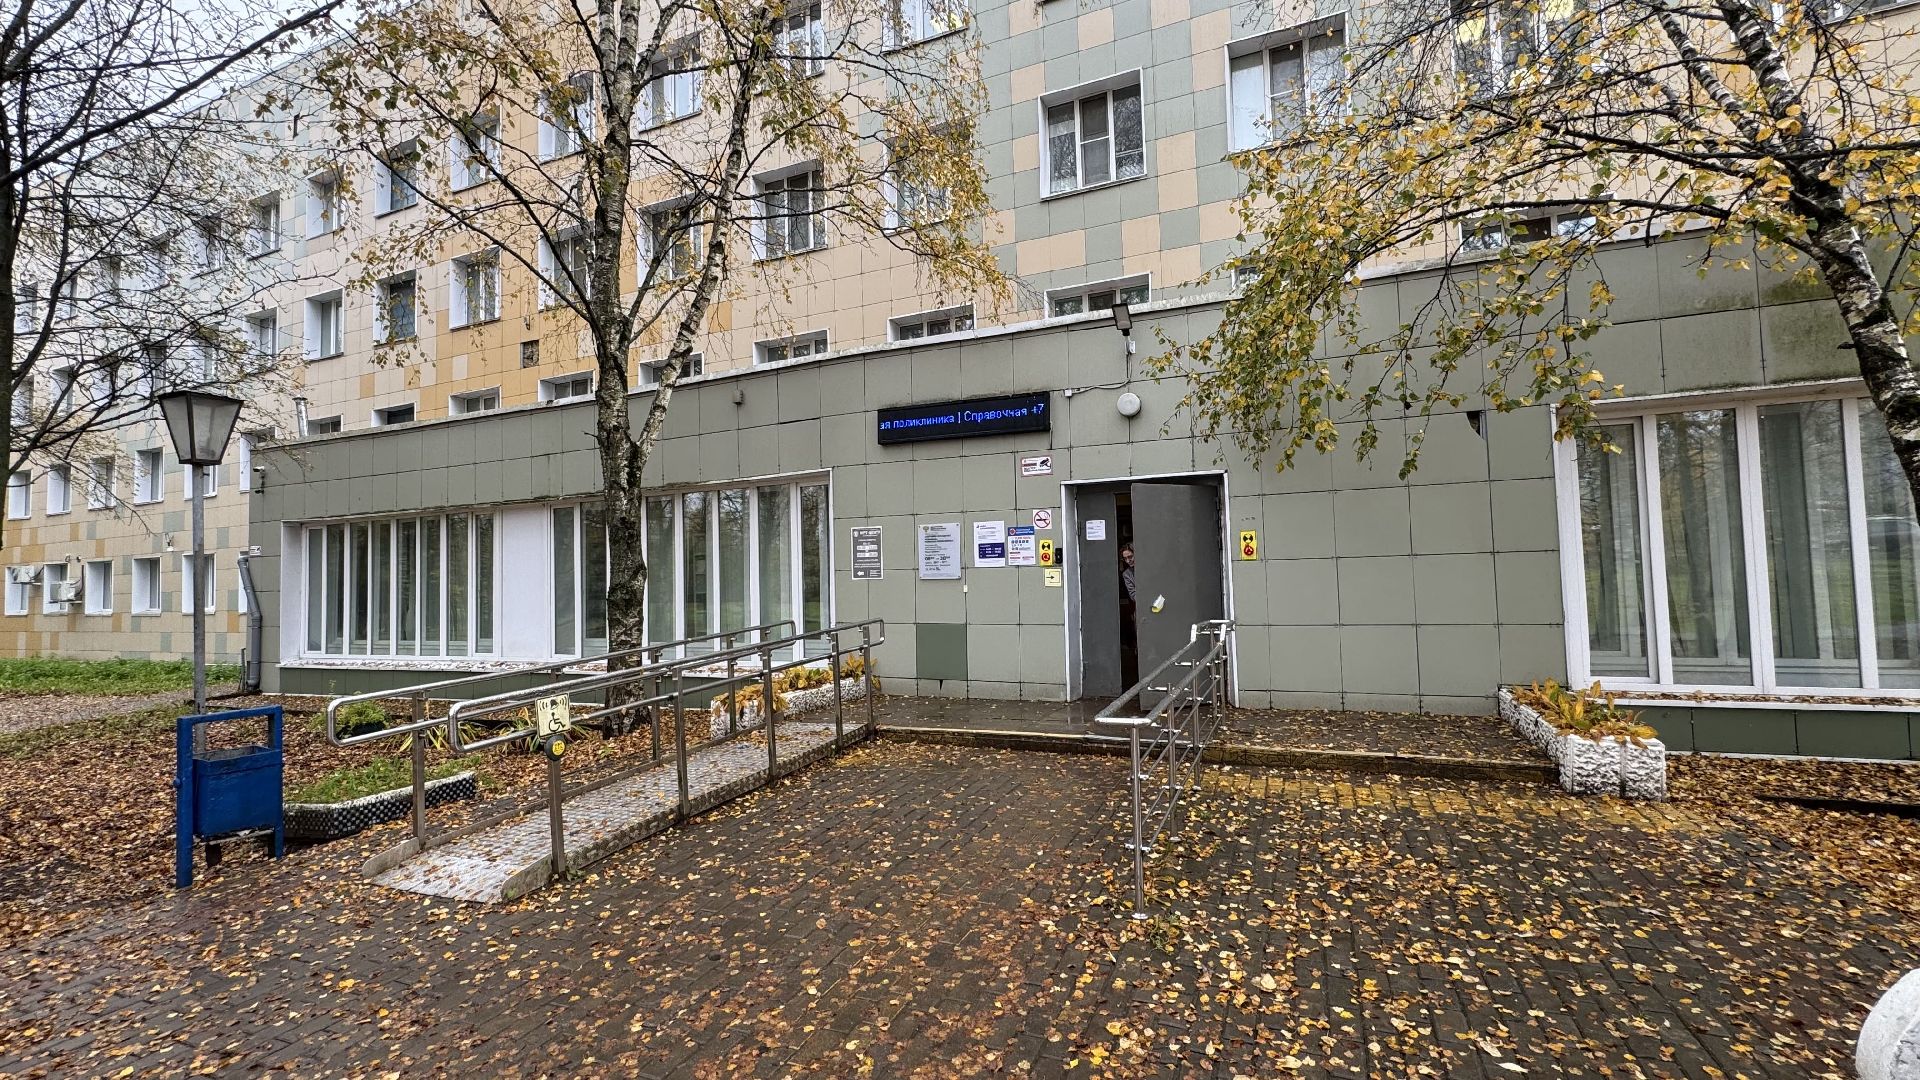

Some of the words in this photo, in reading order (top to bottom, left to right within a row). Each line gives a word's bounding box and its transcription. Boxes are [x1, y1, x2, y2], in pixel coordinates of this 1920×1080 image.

[893, 415, 955, 429] поликлиника
[963, 408, 1028, 423] Справочная
[1031, 403, 1045, 415] +7
